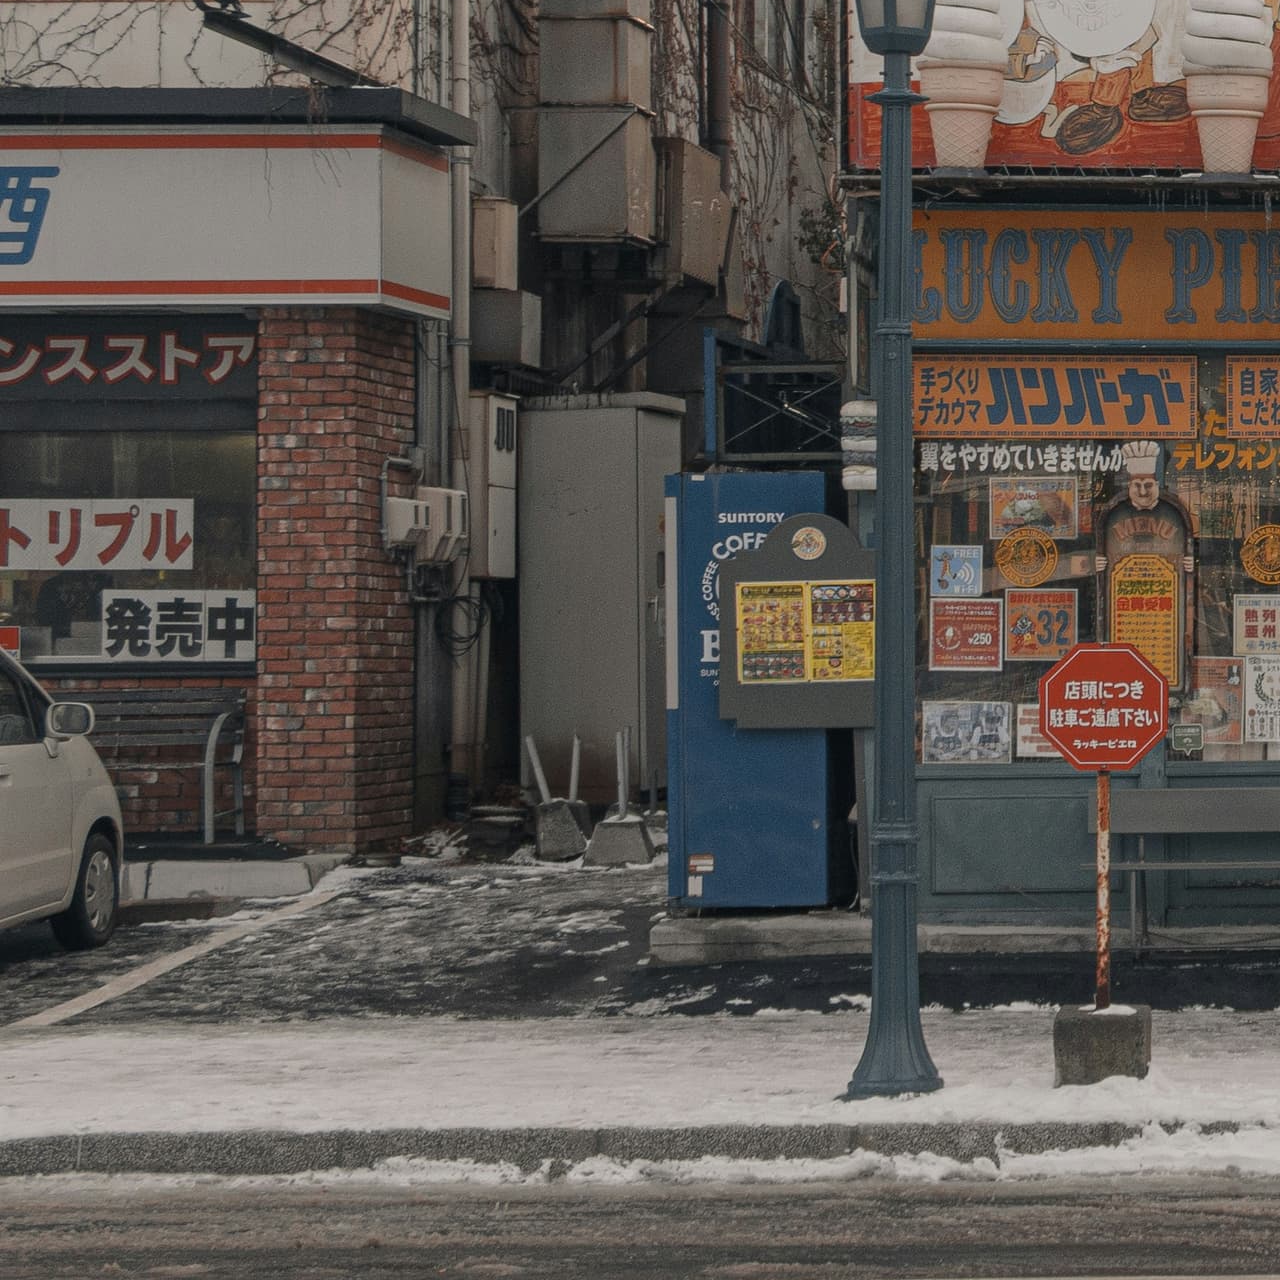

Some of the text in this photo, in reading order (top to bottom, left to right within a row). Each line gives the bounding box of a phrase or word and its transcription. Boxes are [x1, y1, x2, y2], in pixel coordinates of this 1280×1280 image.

[909, 227, 1133, 324] LUCKY
[919, 368, 980, 394] 手づくり
[986, 367, 1186, 426] ハンバーガー
[918, 398, 981, 426] デカウマ
[718, 512, 784, 524] SUNTORY
[712, 532, 767, 560] COFF
[953, 549, 980, 559] FREE
[702, 560, 719, 601] COFFEE
[105, 597, 255, 658] 発売中
[1036, 610, 1070, 646] 32
[1064, 680, 1145, 700] 店頭につき
[1049, 708, 1160, 728] 駐車ご遠慮下さい
[1072, 738, 1137, 749] ラッキーピエロ
